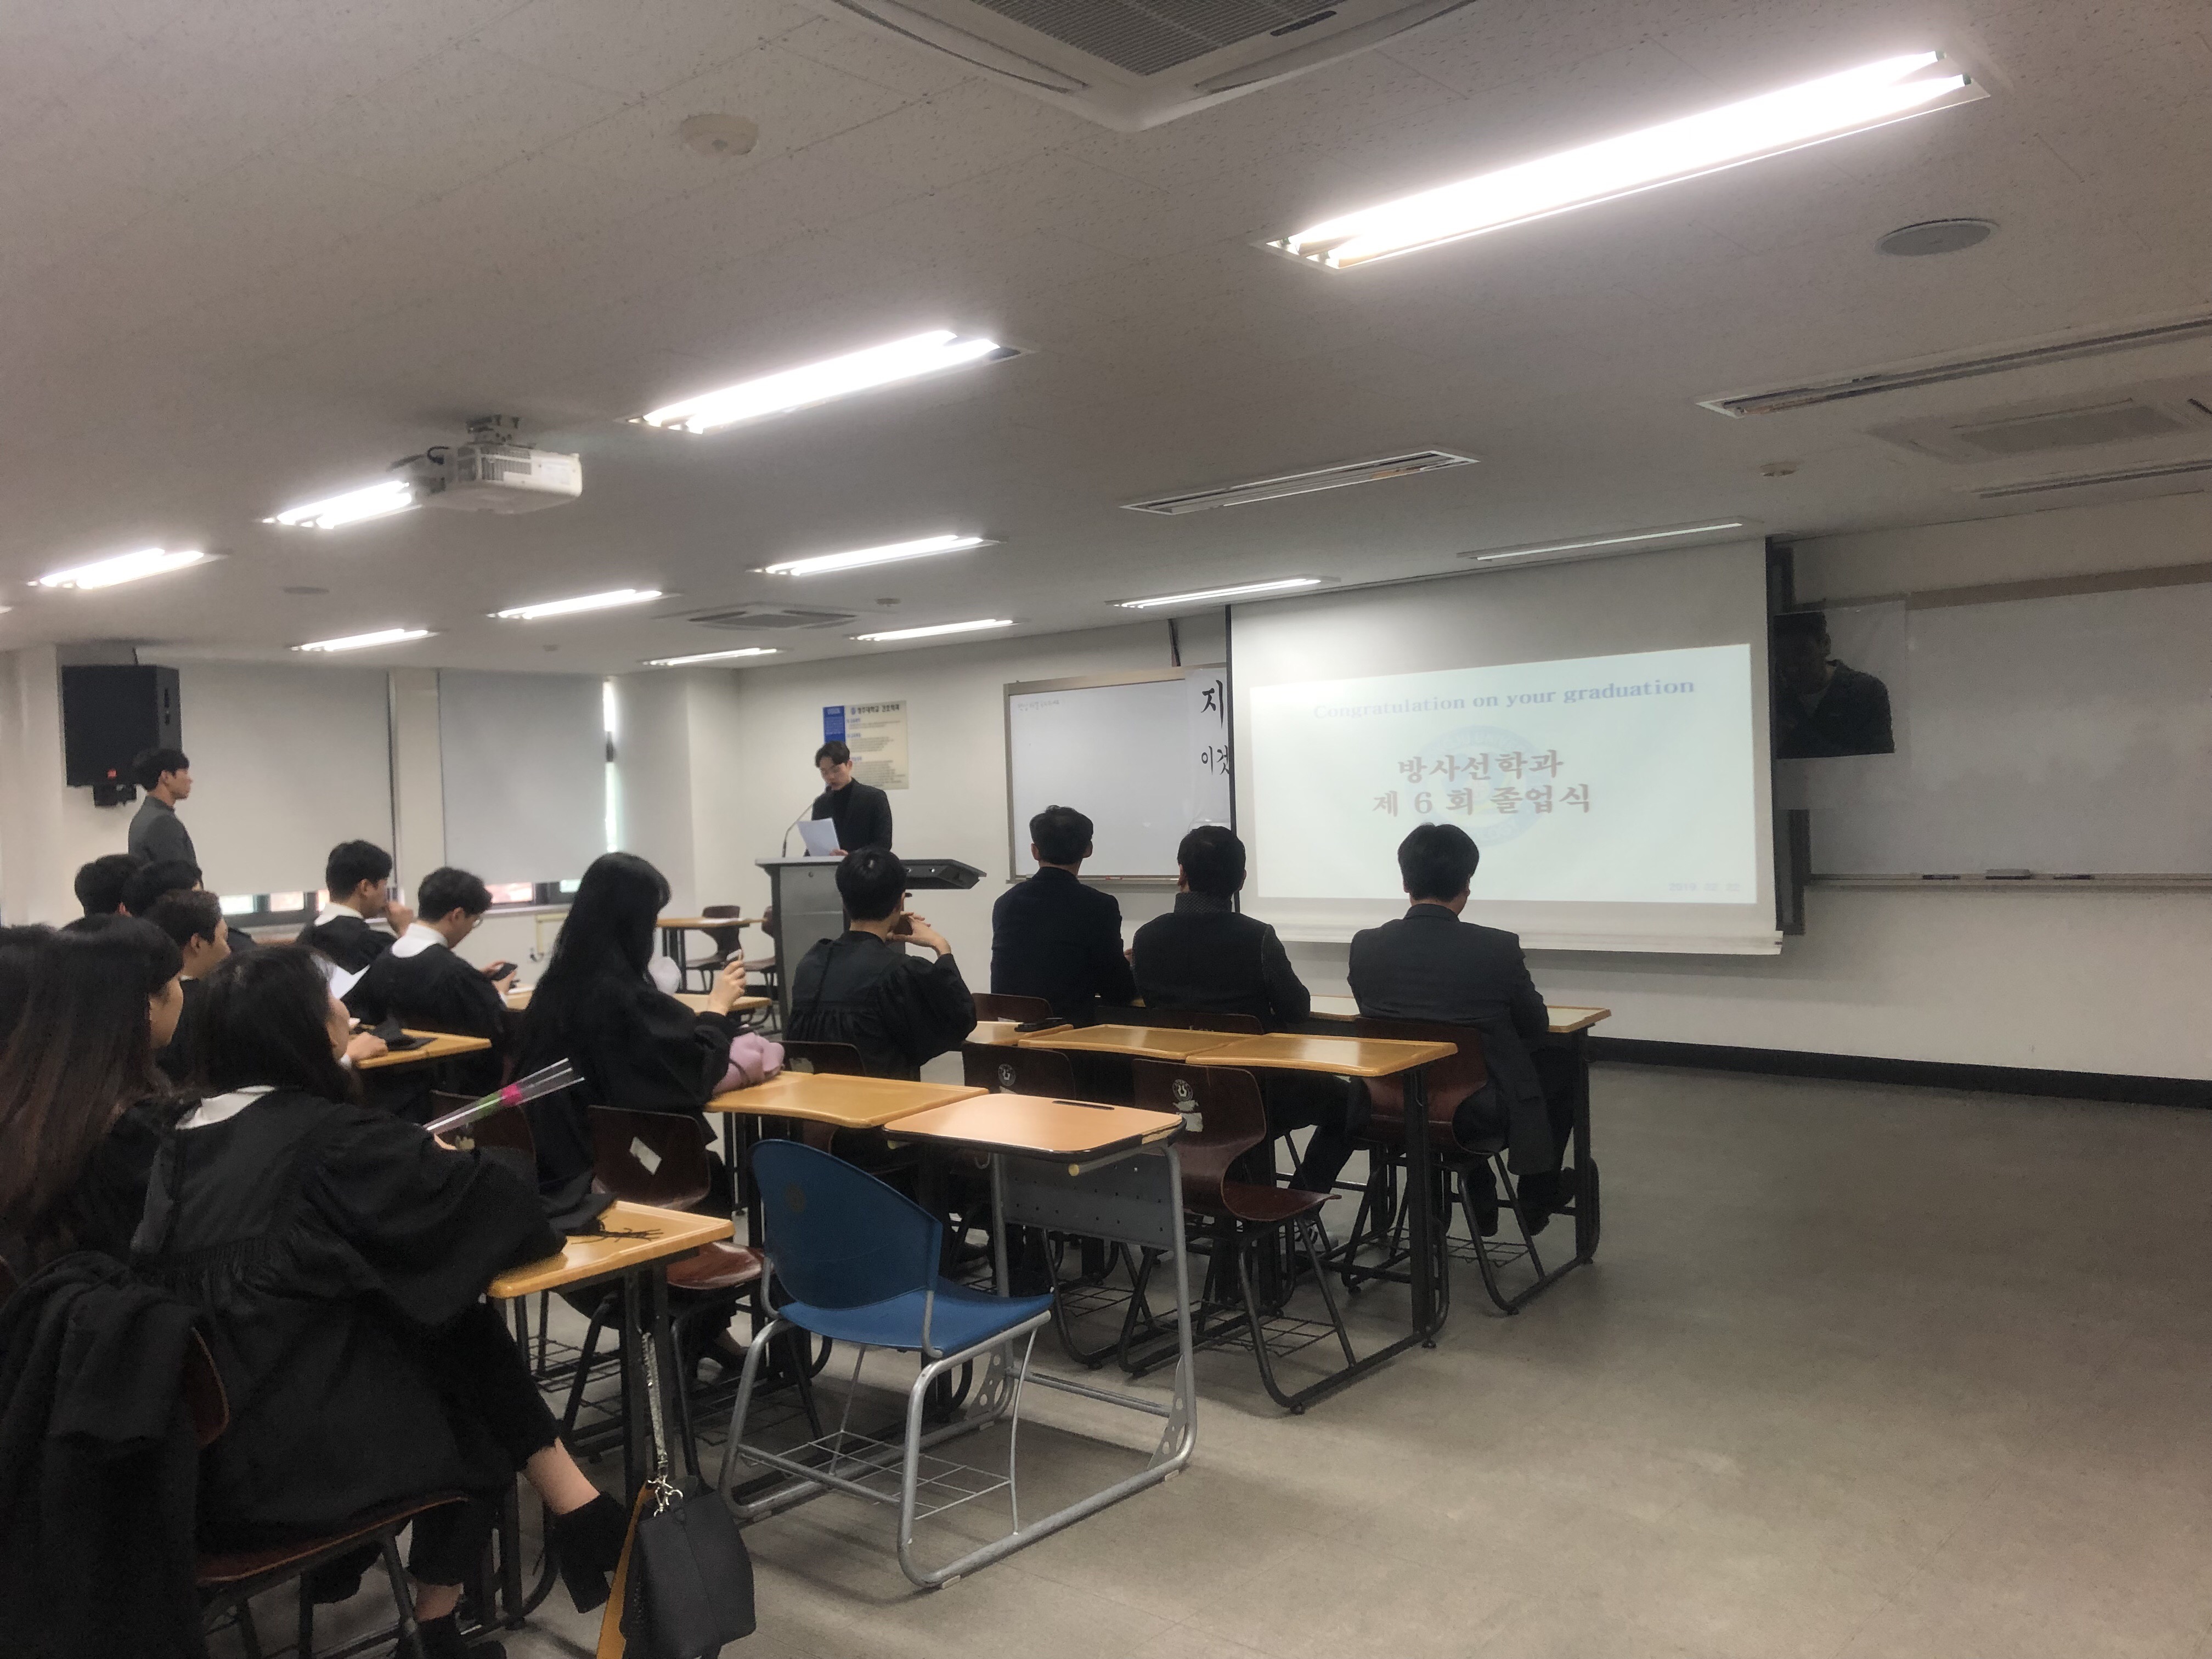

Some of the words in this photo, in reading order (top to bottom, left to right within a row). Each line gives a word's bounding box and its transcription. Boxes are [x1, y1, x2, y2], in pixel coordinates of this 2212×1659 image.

[1201, 680, 1224, 729] 지
[1313, 697, 1465, 719] Congratulation
[1473, 696, 1499, 708] on
[1506, 691, 1556, 707] your
[1563, 680, 1695, 704] graduation
[1201, 744, 1230, 775] 이것
[1397, 749, 1564, 784] 방사선학과
[1372, 790, 1398, 817] 제
[1414, 791, 1434, 814] 6
[1446, 787, 1473, 816] 회
[1489, 783, 1590, 814] 졸업식
